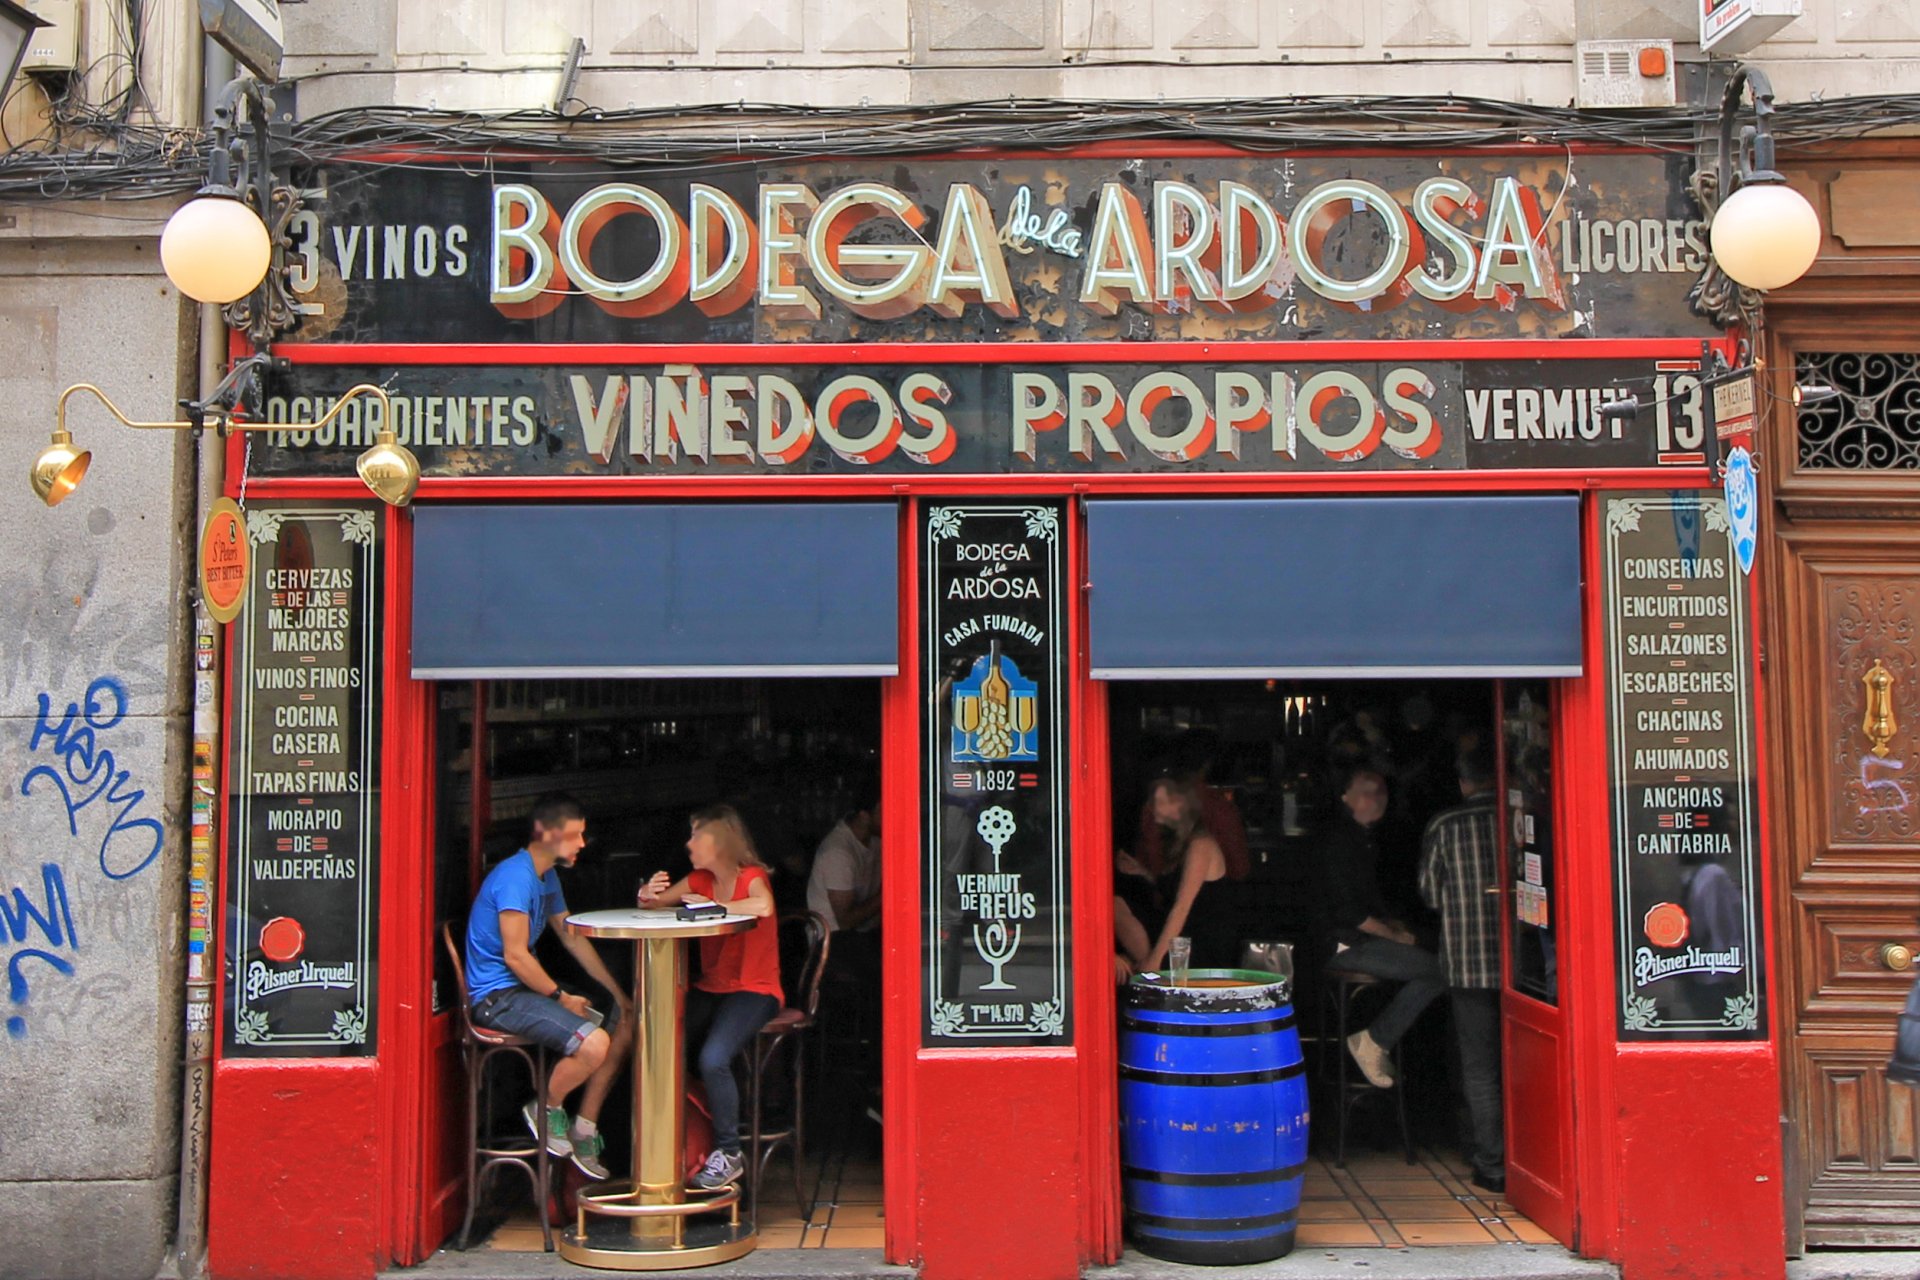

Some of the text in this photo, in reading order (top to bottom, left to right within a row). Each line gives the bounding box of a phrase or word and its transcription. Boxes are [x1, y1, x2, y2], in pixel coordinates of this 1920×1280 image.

[333, 225, 468, 279] VINOS
[490, 183, 1004, 306] BODEGA
[1079, 176, 1550, 304] ARDOSA
[1562, 218, 1707, 273] LICORES
[267, 396, 535, 447] AGUARDIENTES
[570, 363, 1440, 463] VIÑEDOS PROPIOS
[1465, 388, 1628, 440] VERMUT
[1653, 374, 1704, 450] 13
[956, 543, 1031, 562] BODEGA
[266, 568, 353, 590] CERVEZAS
[980, 562, 1008, 578] de la
[1624, 558, 1725, 580] CONSERVAS
[287, 590, 331, 608] DE LAS
[947, 577, 1042, 600] ARDOSA
[268, 607, 349, 629] MEJORES
[1623, 596, 1729, 618] ENCURTIDOS
[272, 630, 344, 652] MARCAS
[943, 614, 1045, 647] CASA FUNDADA
[1627, 634, 1727, 656] SALAZONES
[256, 667, 360, 689] VINOS FINOS
[1623, 672, 1734, 694] ESCABECHES
[275, 705, 339, 728] COCINA
[1637, 710, 1723, 732] CHACINAS
[272, 732, 341, 755] CASERA
[1634, 748, 1730, 771] AHUMADOS
[253, 771, 359, 793] TAPAS FINAS
[975, 770, 1015, 791] 1.892
[1643, 787, 1724, 809] ANCHOAS
[268, 809, 342, 831] MORAPIO
[1675, 812, 1693, 830] DE
[294, 835, 311, 853] DE
[1637, 833, 1732, 855] CANTABRIA
[253, 854, 356, 880] VALDEPEÑAS
[956, 874, 1021, 894] VERMUT
[961, 893, 1036, 919] DE REUS
[1635, 945, 1741, 988] Pilsner Urquell
[247, 959, 354, 1000] Pilsner Urquell
